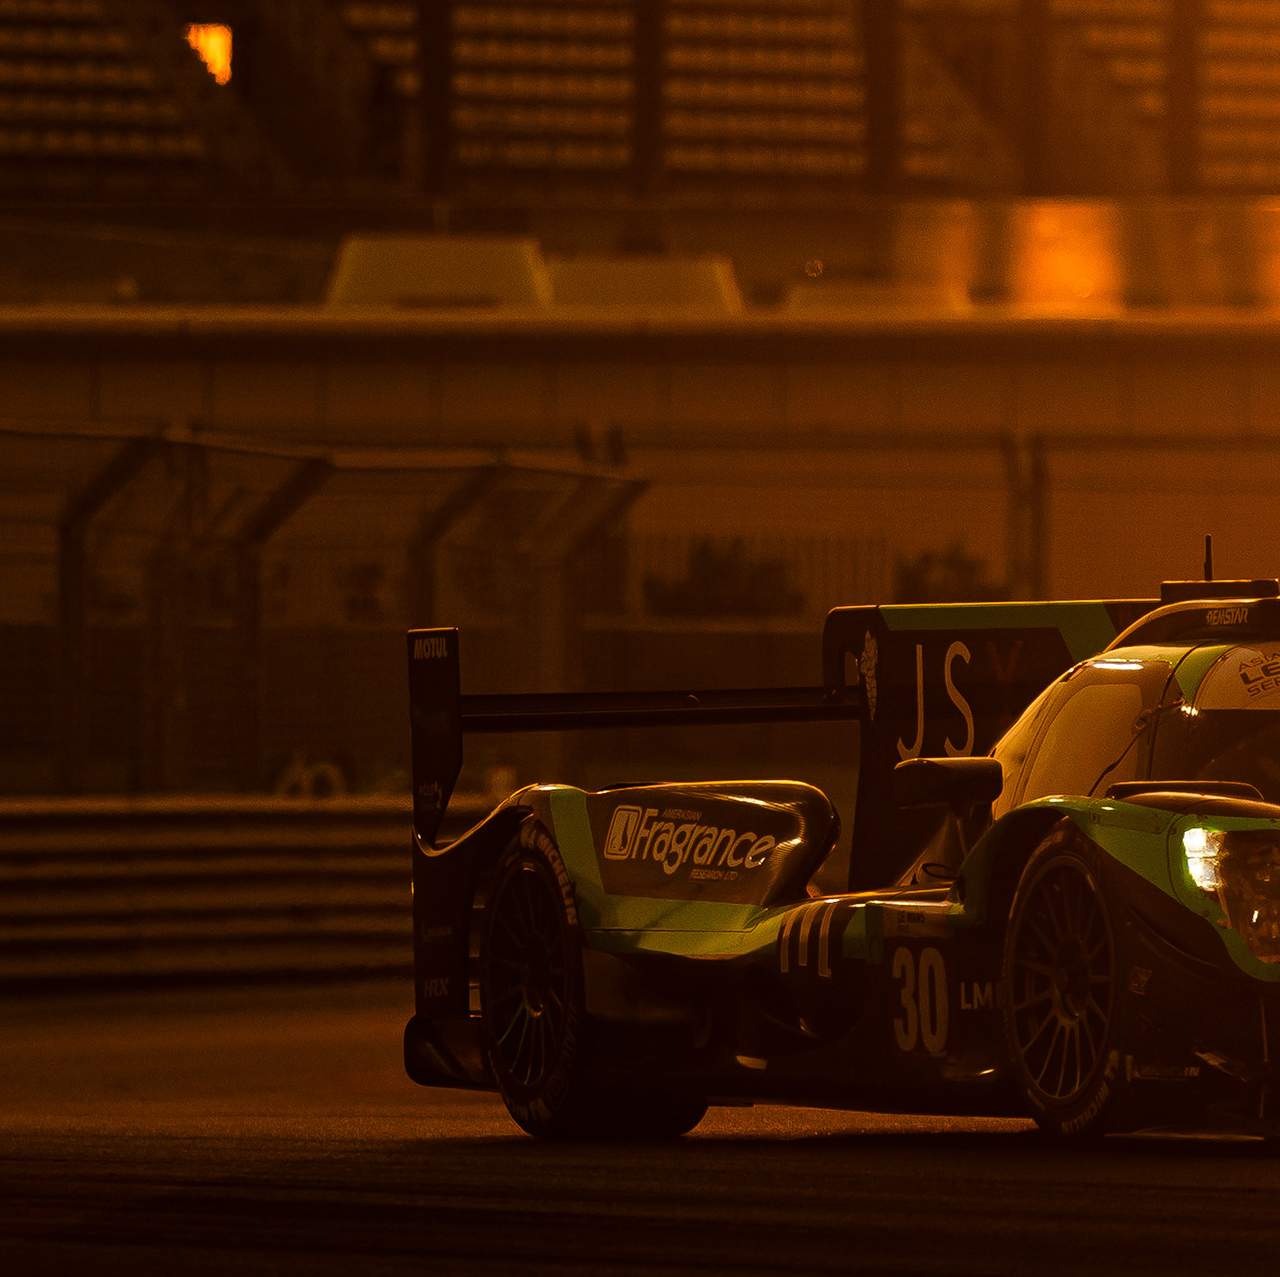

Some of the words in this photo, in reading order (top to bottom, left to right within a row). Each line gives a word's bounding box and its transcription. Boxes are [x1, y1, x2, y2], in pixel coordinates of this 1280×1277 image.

[413, 636, 448, 659] MOTUL
[631, 808, 776, 875] Fragrance
[537, 833, 578, 925] MICHELIN
[892, 946, 949, 1057] 30
[1061, 1081, 1110, 1134] MICHELIN
